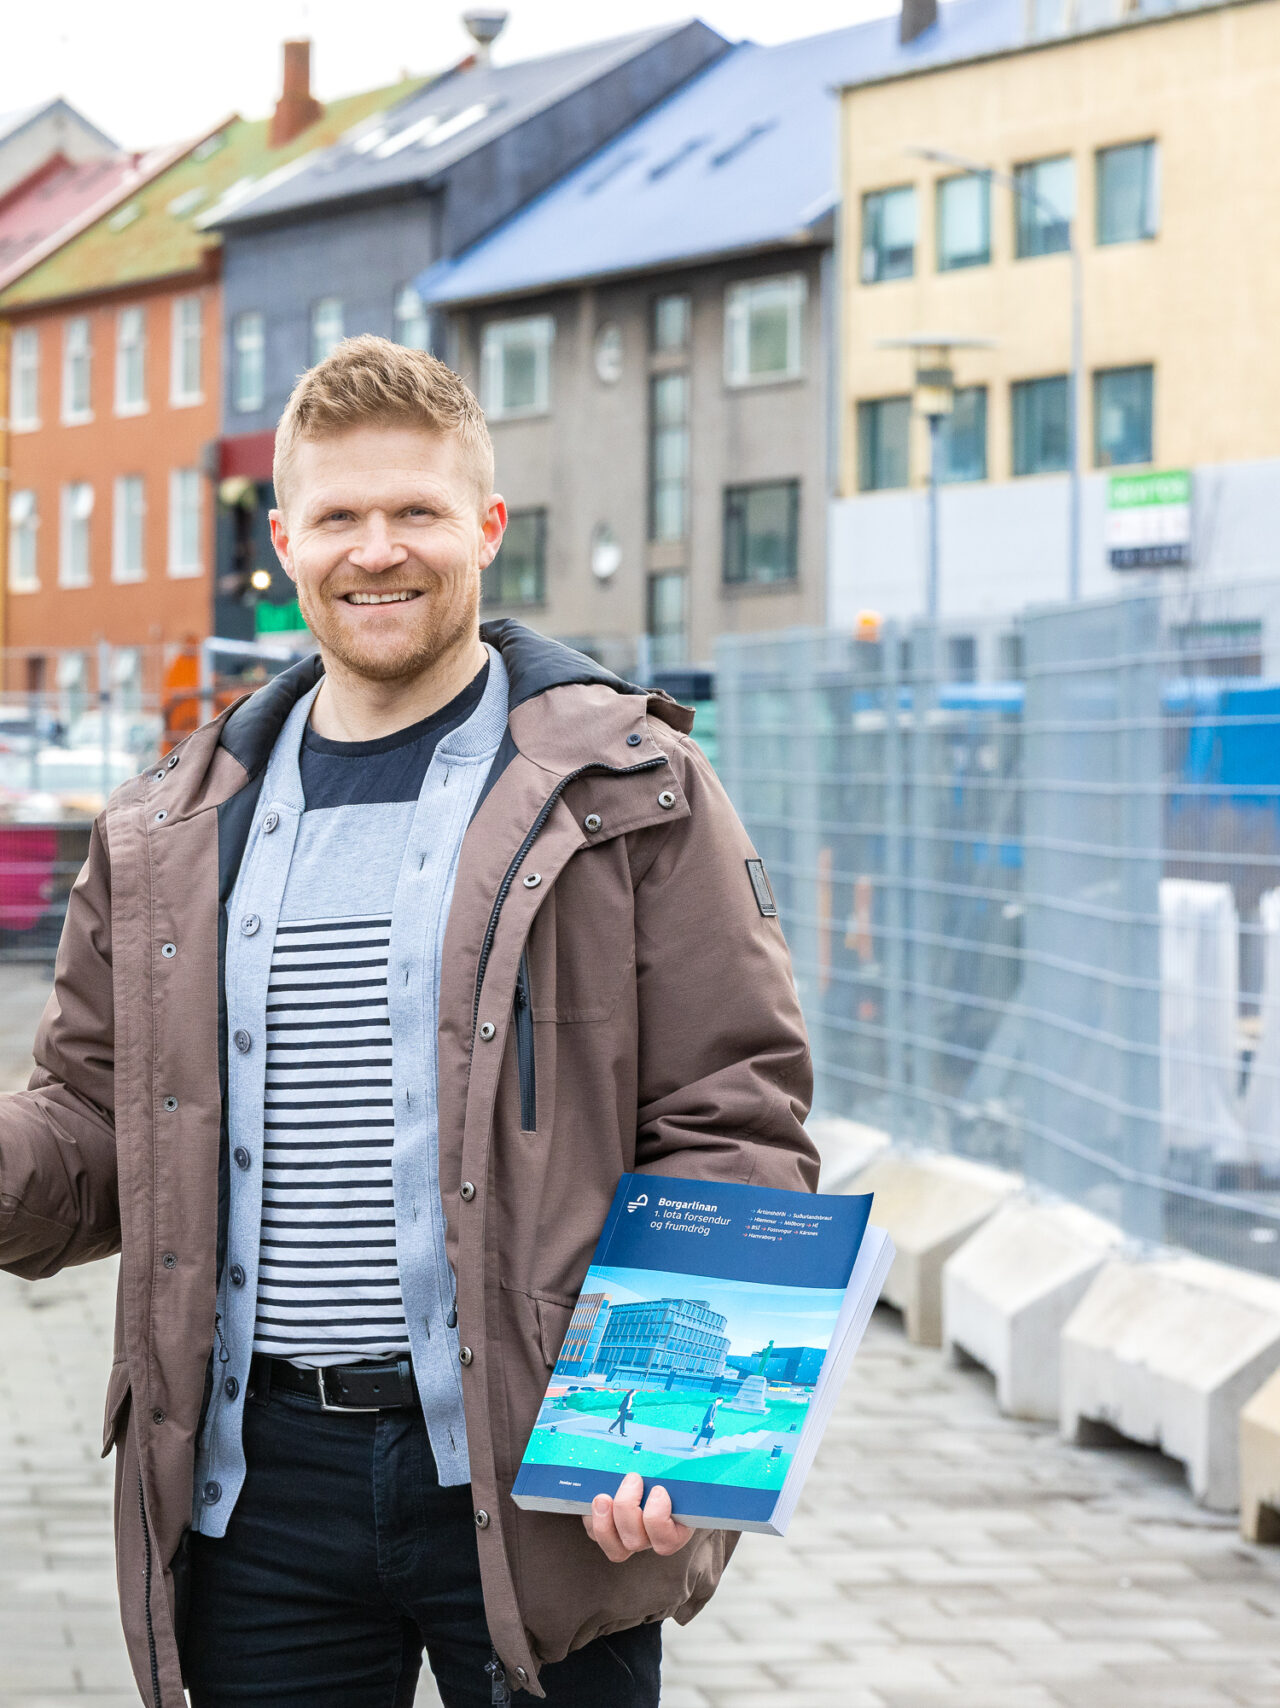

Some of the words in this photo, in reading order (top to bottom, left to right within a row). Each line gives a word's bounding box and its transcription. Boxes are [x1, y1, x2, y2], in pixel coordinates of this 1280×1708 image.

[658, 1197, 718, 1213] Borgarlínan
[663, 1209, 681, 1220] lota
[683, 1211, 732, 1226] forsendur
[650, 1220, 663, 1231] og
[664, 1221, 711, 1236] frumdrög
